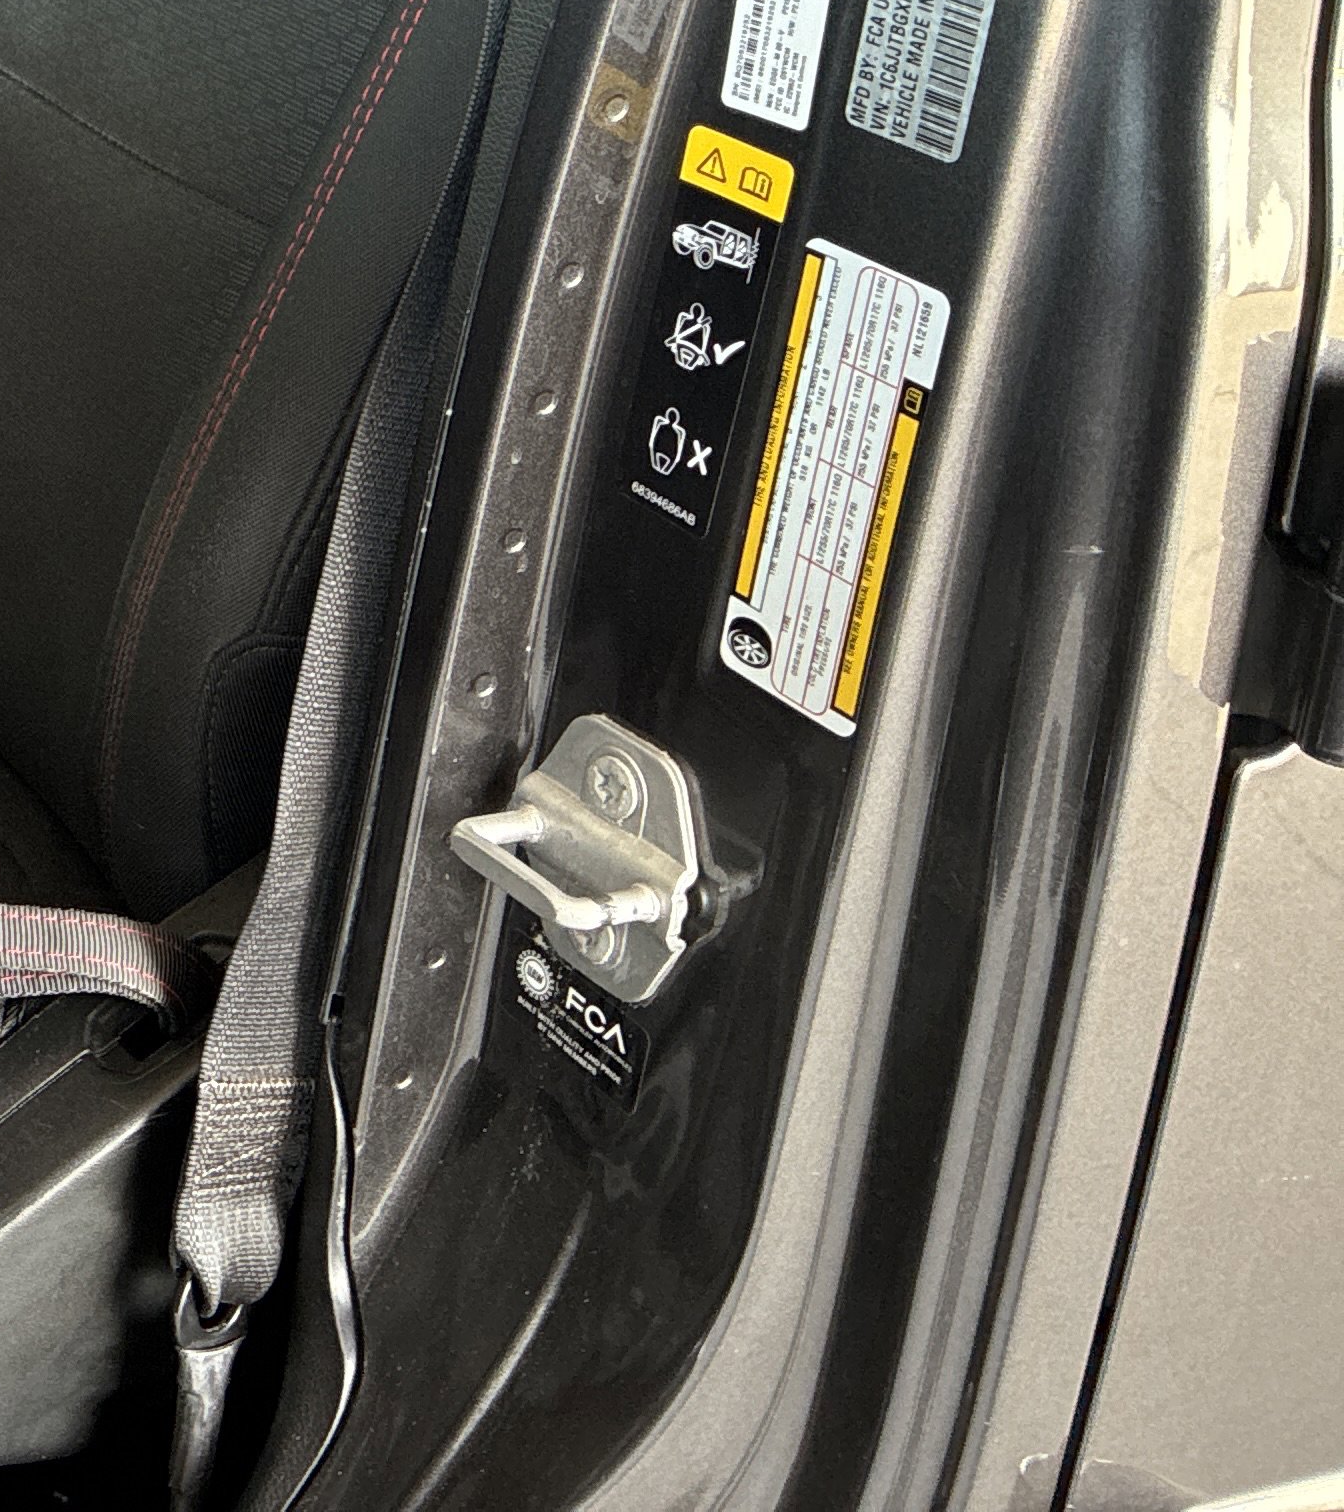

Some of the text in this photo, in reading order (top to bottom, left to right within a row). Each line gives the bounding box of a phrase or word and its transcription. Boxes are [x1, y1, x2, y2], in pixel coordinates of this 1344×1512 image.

[865, 13, 885, 47] FCA
[858, 51, 877, 81] BY:
[890, 69, 920, 141] VEHICLE
[905, 15, 931, 67] MADE
[850, 85, 871, 123] MFD
[869, 95, 892, 132] VIN:
[911, 300, 933, 358] NL121659
[758, 460, 770, 484] AND
[565, 986, 627, 1055] FCA
